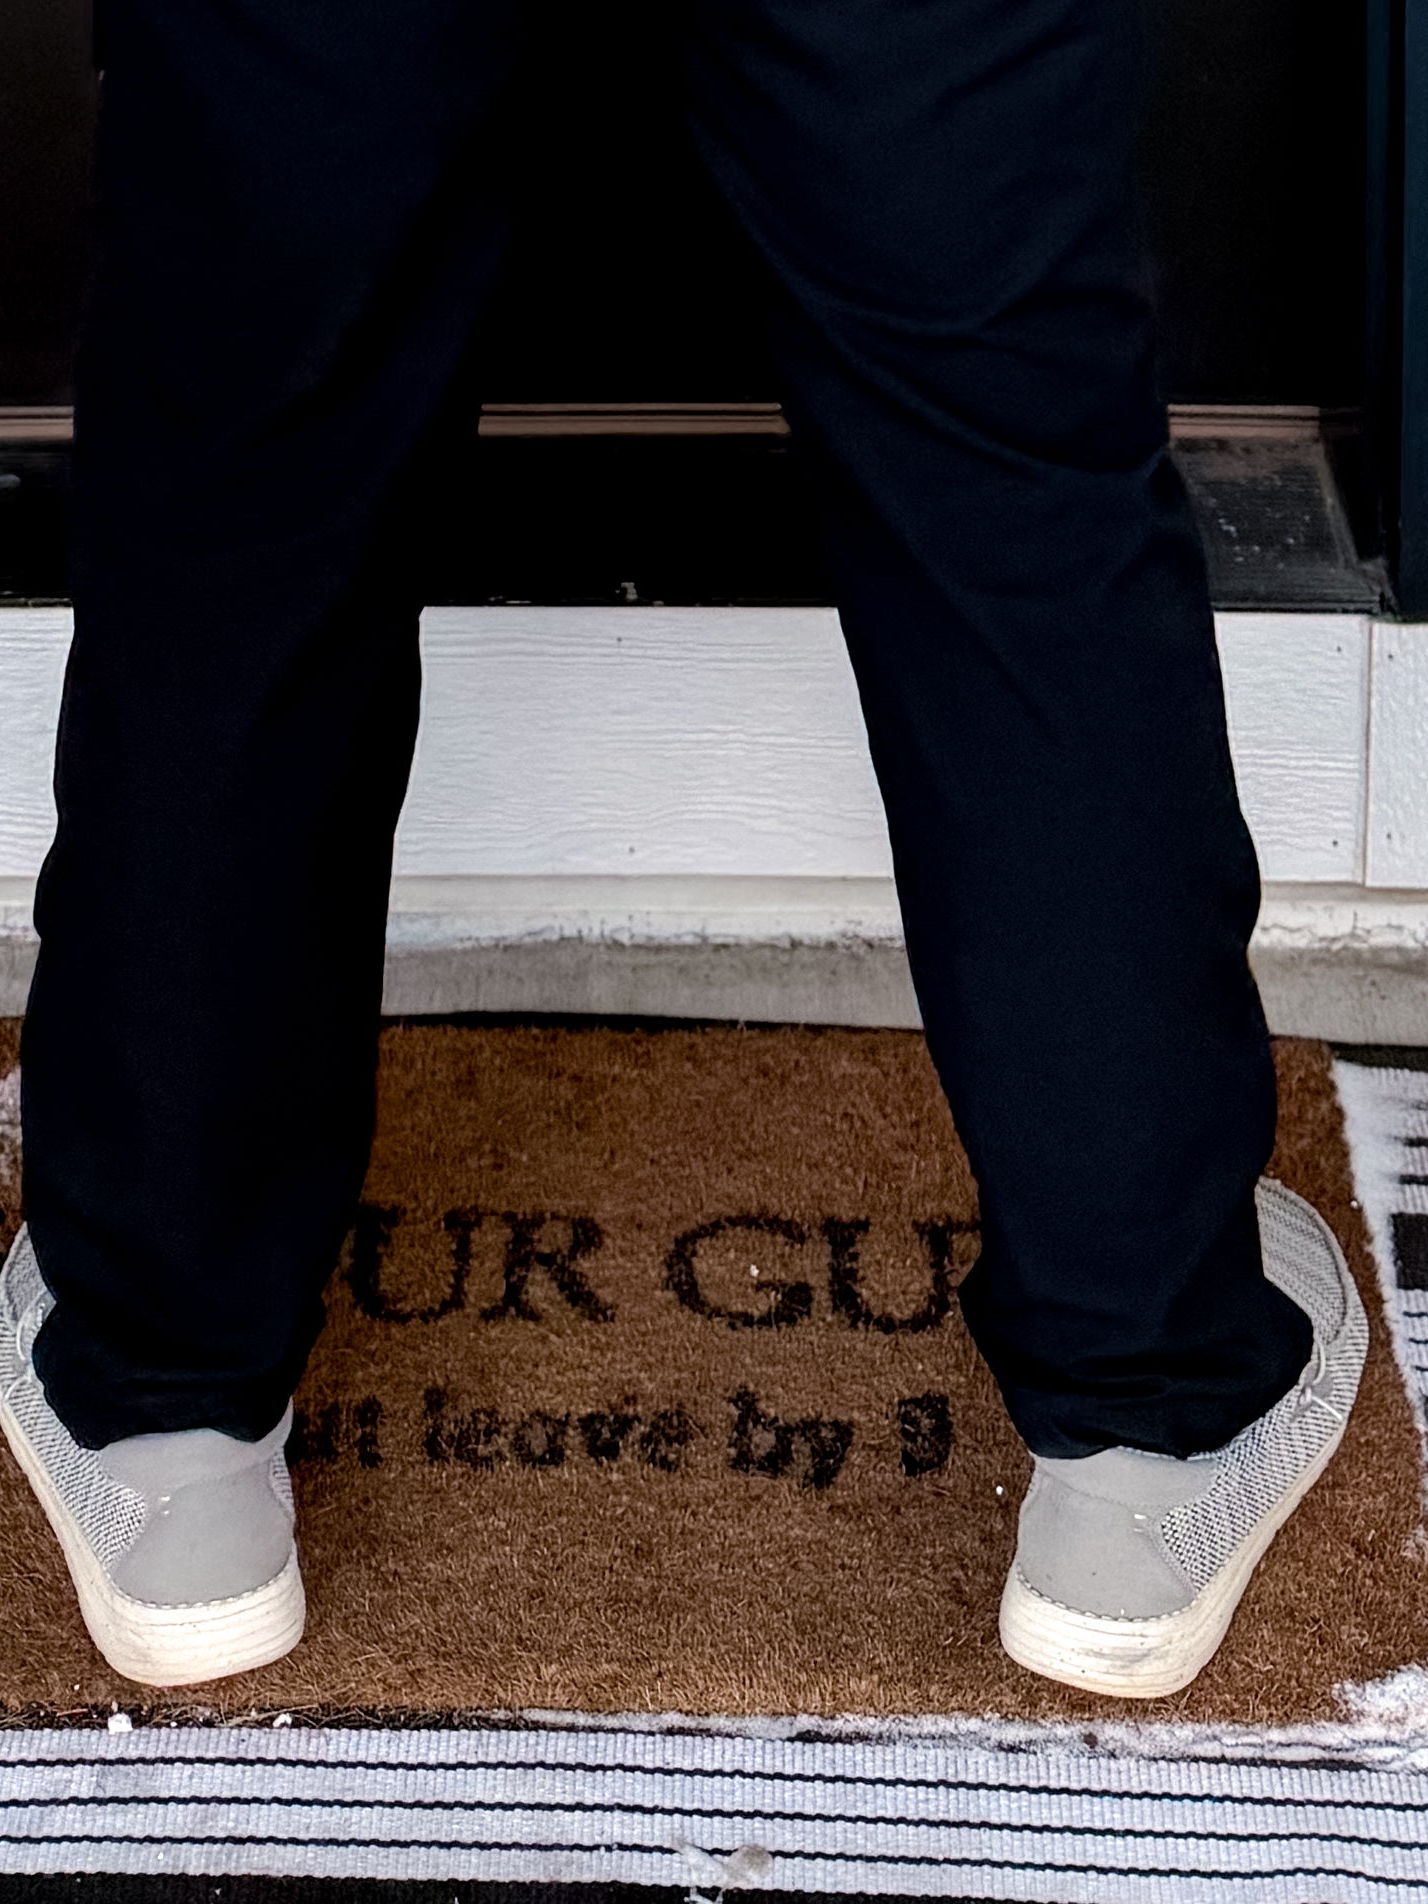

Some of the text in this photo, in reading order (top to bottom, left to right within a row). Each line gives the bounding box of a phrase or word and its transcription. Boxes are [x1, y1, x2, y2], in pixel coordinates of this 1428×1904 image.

[341, 1204, 616, 1324] UR
[666, 1214, 980, 1334] GU
[725, 1385, 854, 1490] by
